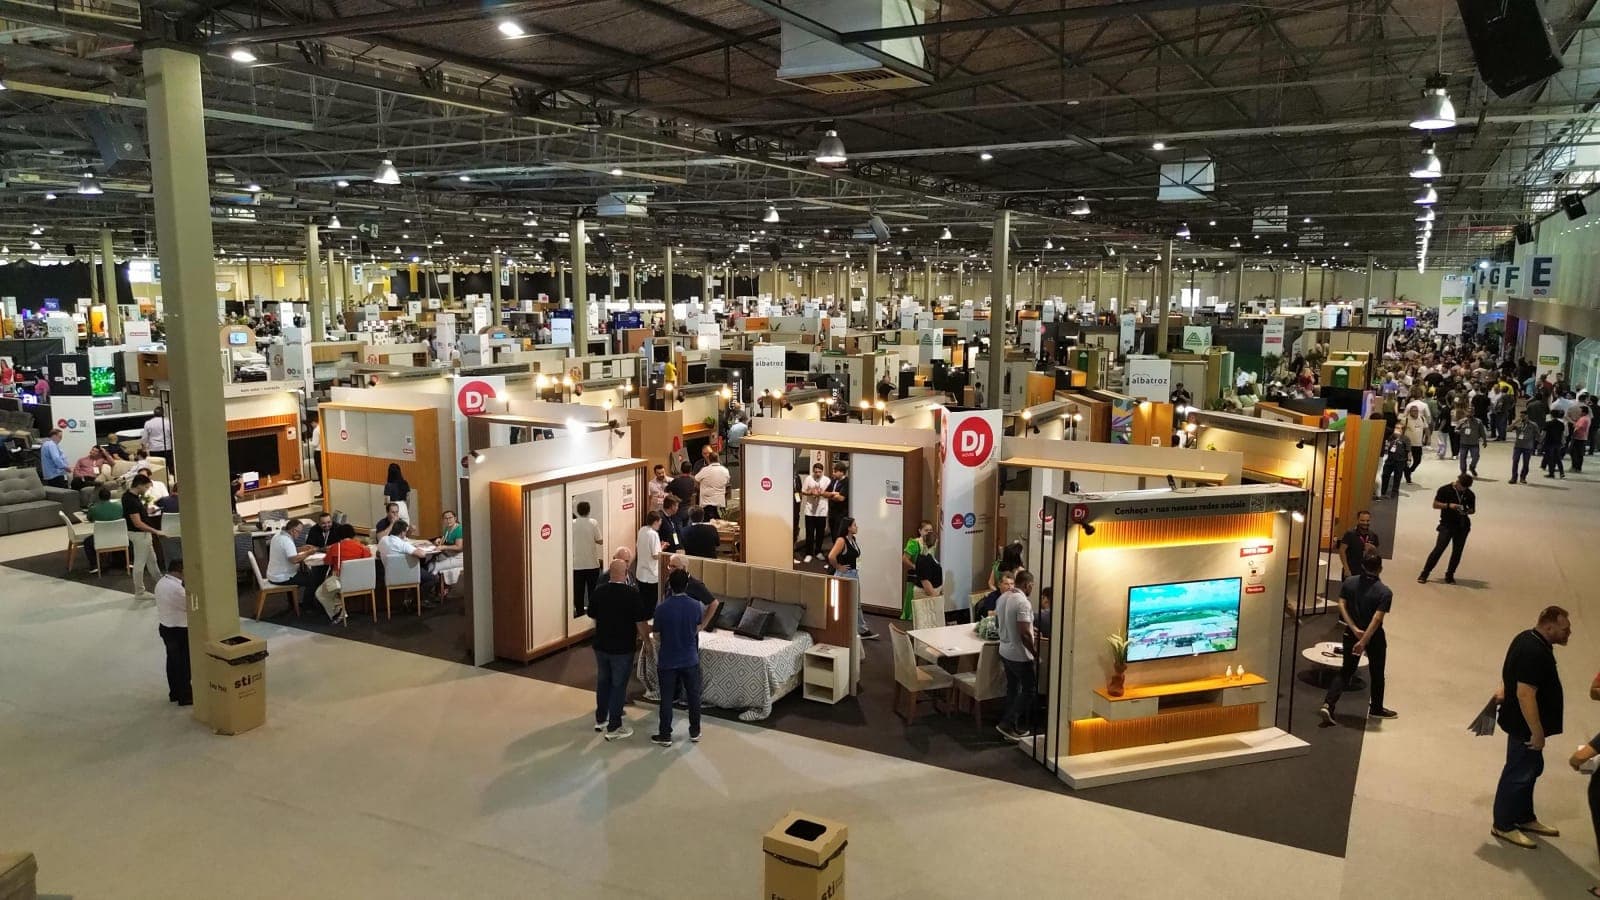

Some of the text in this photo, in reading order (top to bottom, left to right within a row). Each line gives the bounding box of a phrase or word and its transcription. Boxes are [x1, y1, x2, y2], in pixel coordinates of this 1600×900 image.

[1489, 268, 1501, 285] G
[1504, 267, 1520, 288] F
[1531, 257, 1553, 287] E
[1131, 376, 1169, 385] albatroz
[465, 391, 489, 412] DJ
[960, 430, 986, 457] DJ
[1074, 508, 1086, 519] DJ
[1114, 505, 1148, 515] Conheça
[234, 674, 251, 689] sti
